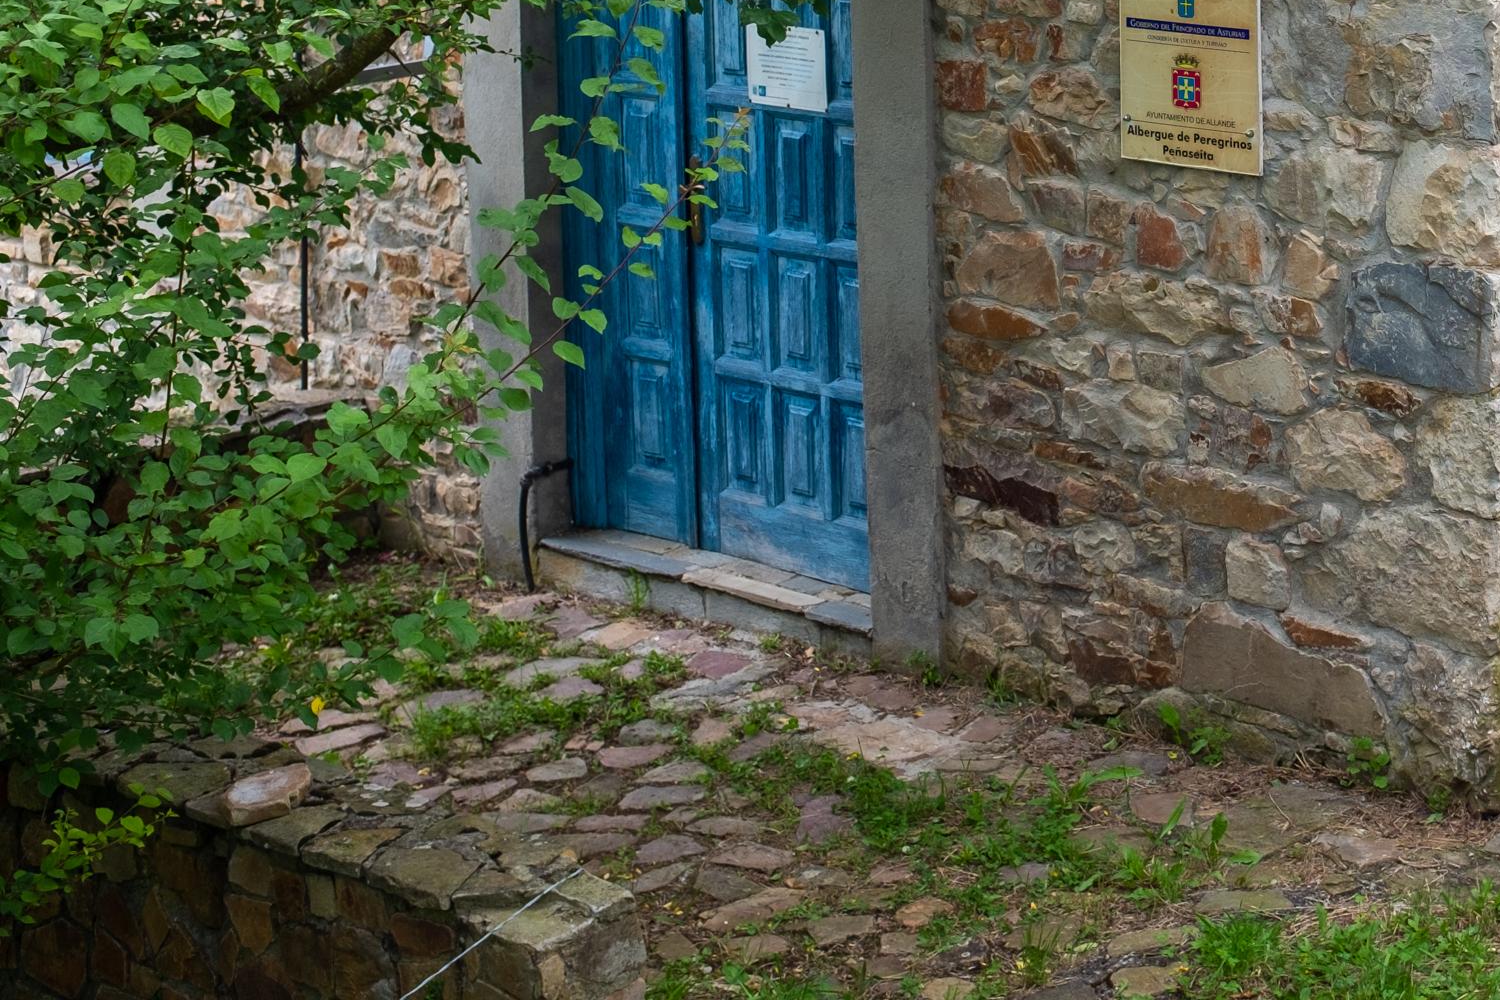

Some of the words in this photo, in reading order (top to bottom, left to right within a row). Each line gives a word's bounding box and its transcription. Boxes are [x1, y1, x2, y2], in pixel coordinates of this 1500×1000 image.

[1171, 23, 1206, 35] PRINCIPADO
[1207, 28, 1216, 36] DE
[1216, 29, 1246, 39] ASTURIAS
[1146, 111, 1195, 124] AYUNTAMIENTO
[1195, 117, 1205, 125] DE
[1206, 118, 1236, 128] ALLANDE
[1127, 125, 1174, 141] Albergue
[1177, 131, 1190, 142] de
[1194, 133, 1252, 150] Peregrinos
[1163, 145, 1214, 161] Peñaseita
